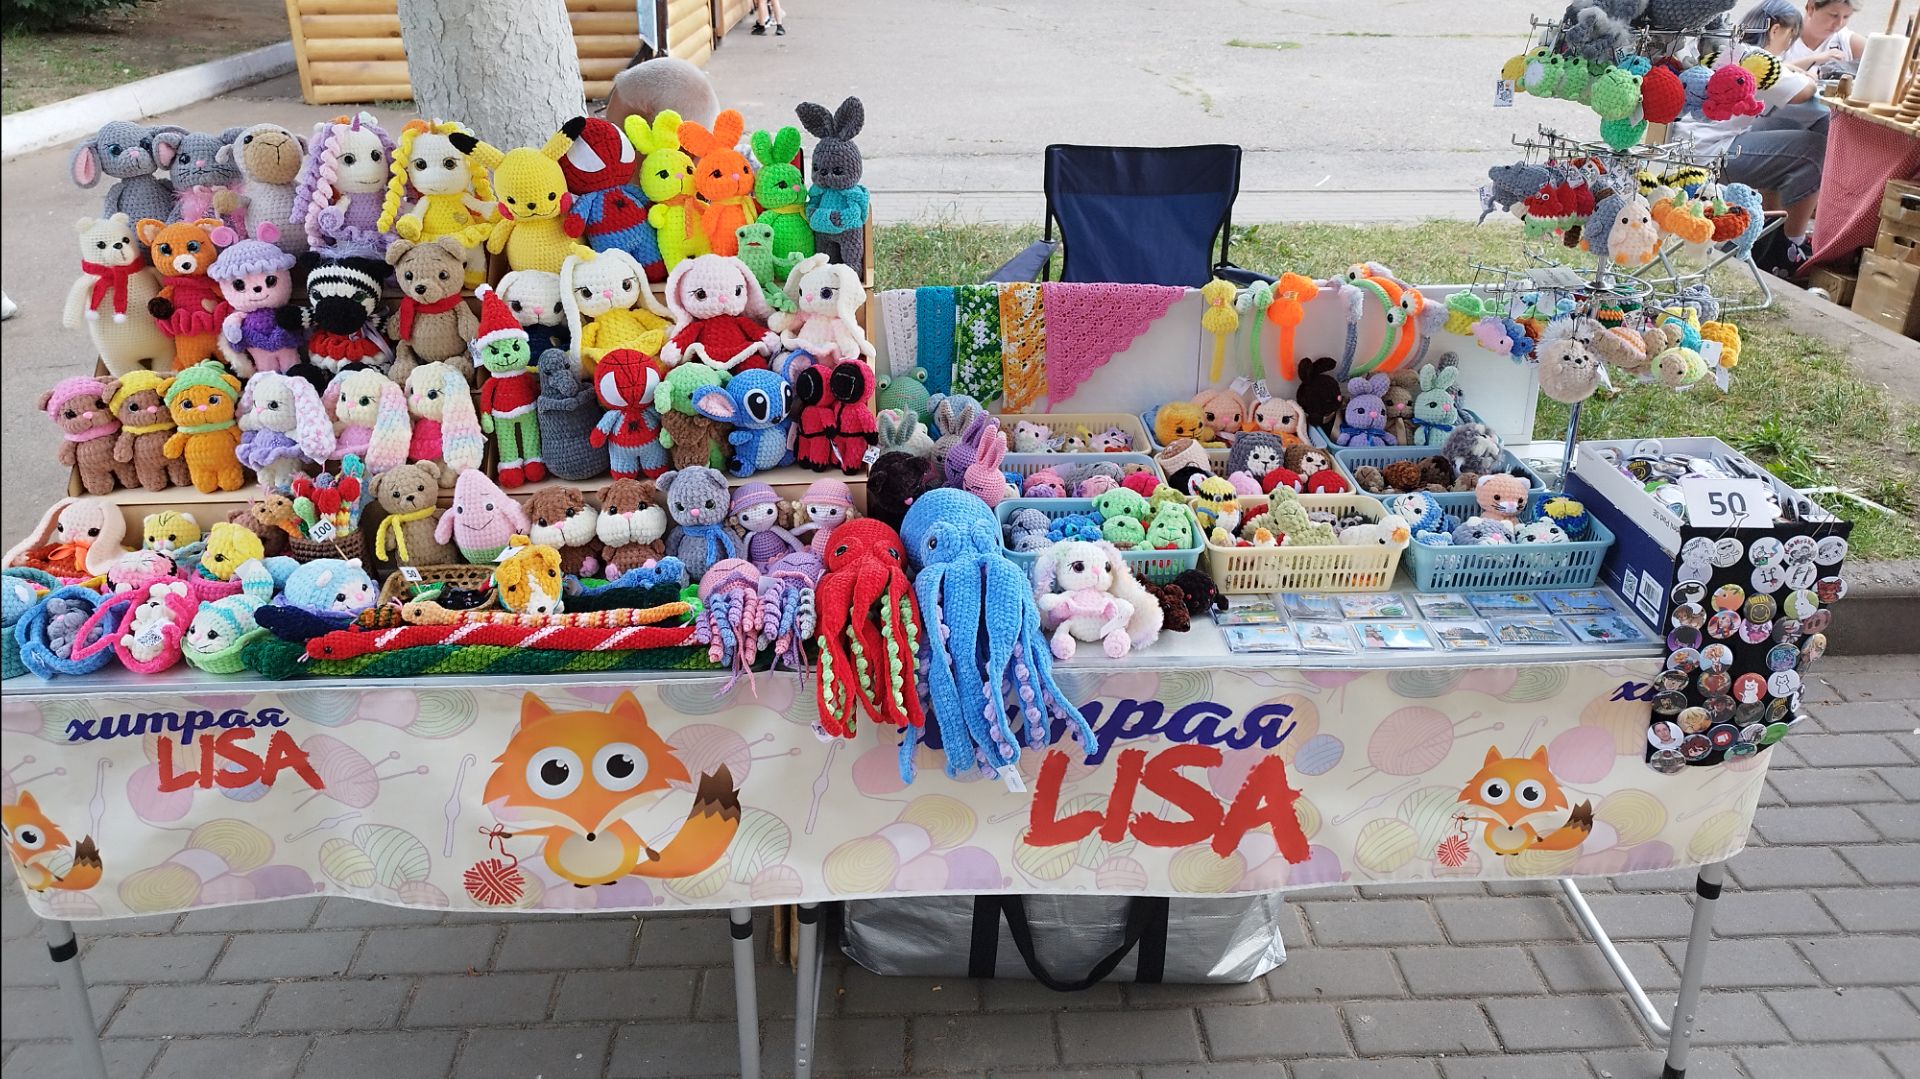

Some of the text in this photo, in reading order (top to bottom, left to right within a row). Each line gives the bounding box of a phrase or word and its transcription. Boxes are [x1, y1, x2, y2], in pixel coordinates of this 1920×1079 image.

[1708, 491, 1747, 517] 50
[313, 522, 332, 539] 100
[65, 707, 290, 745] хитрая
[156, 728, 325, 793] LISA
[1023, 744, 1312, 865] LISA
